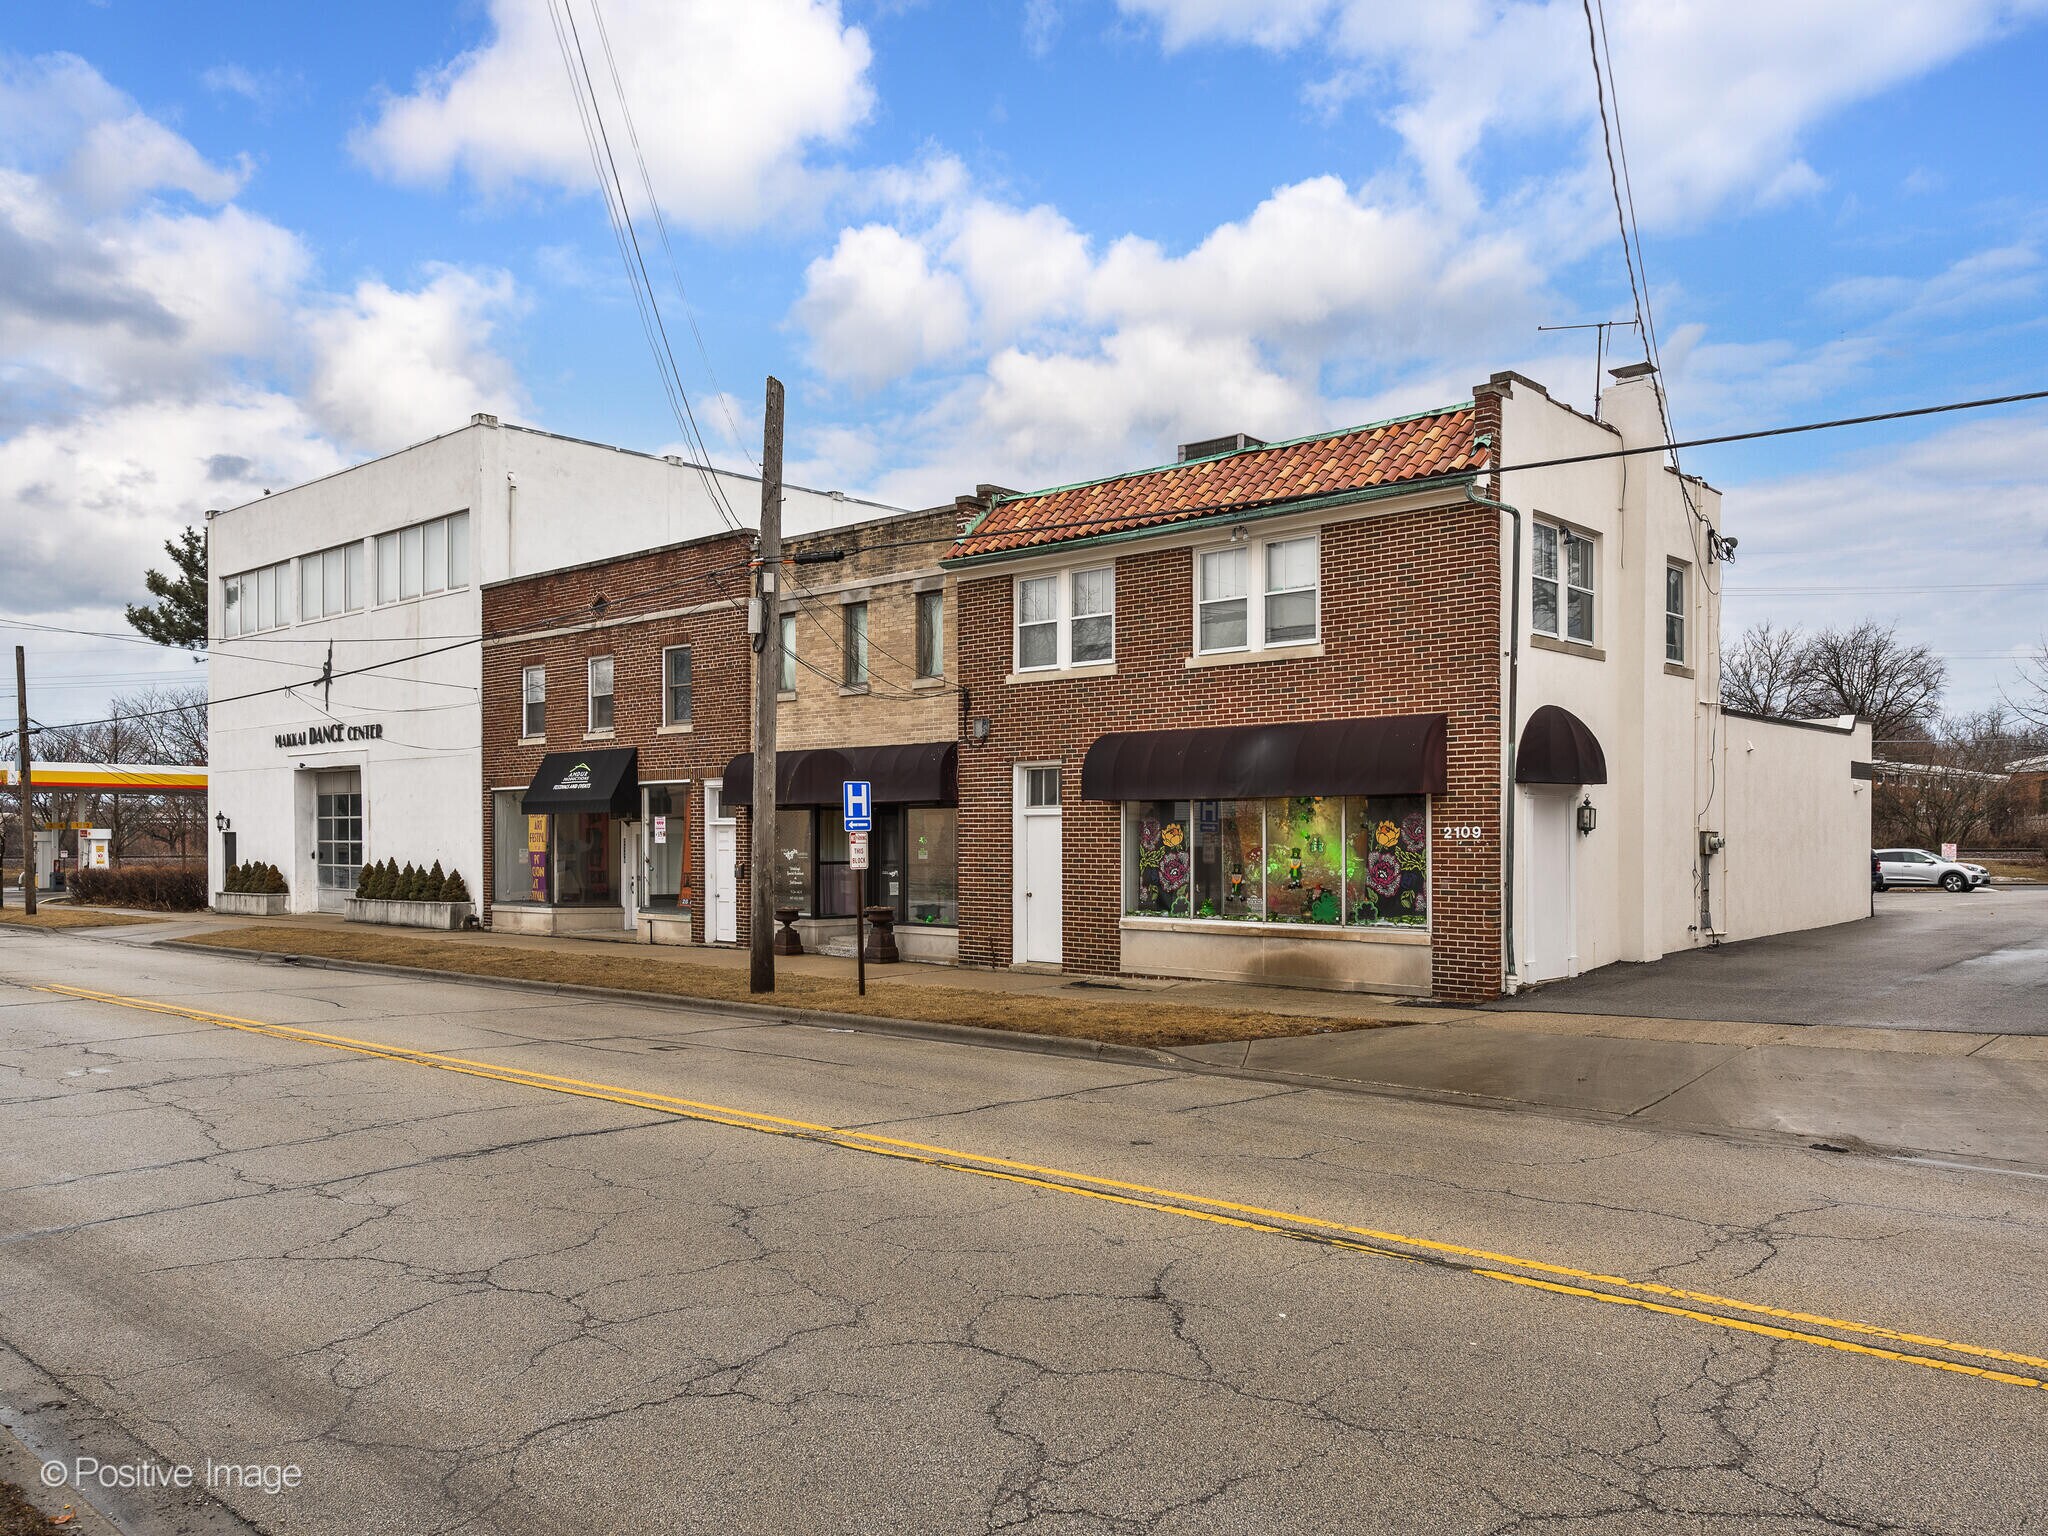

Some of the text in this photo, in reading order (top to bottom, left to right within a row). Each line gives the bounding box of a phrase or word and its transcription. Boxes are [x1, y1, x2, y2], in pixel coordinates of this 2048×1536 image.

[275, 723, 383, 748] MAKKAI DANCE CENTER
[847, 784, 868, 816] H
[1443, 826, 1482, 839] 2109
